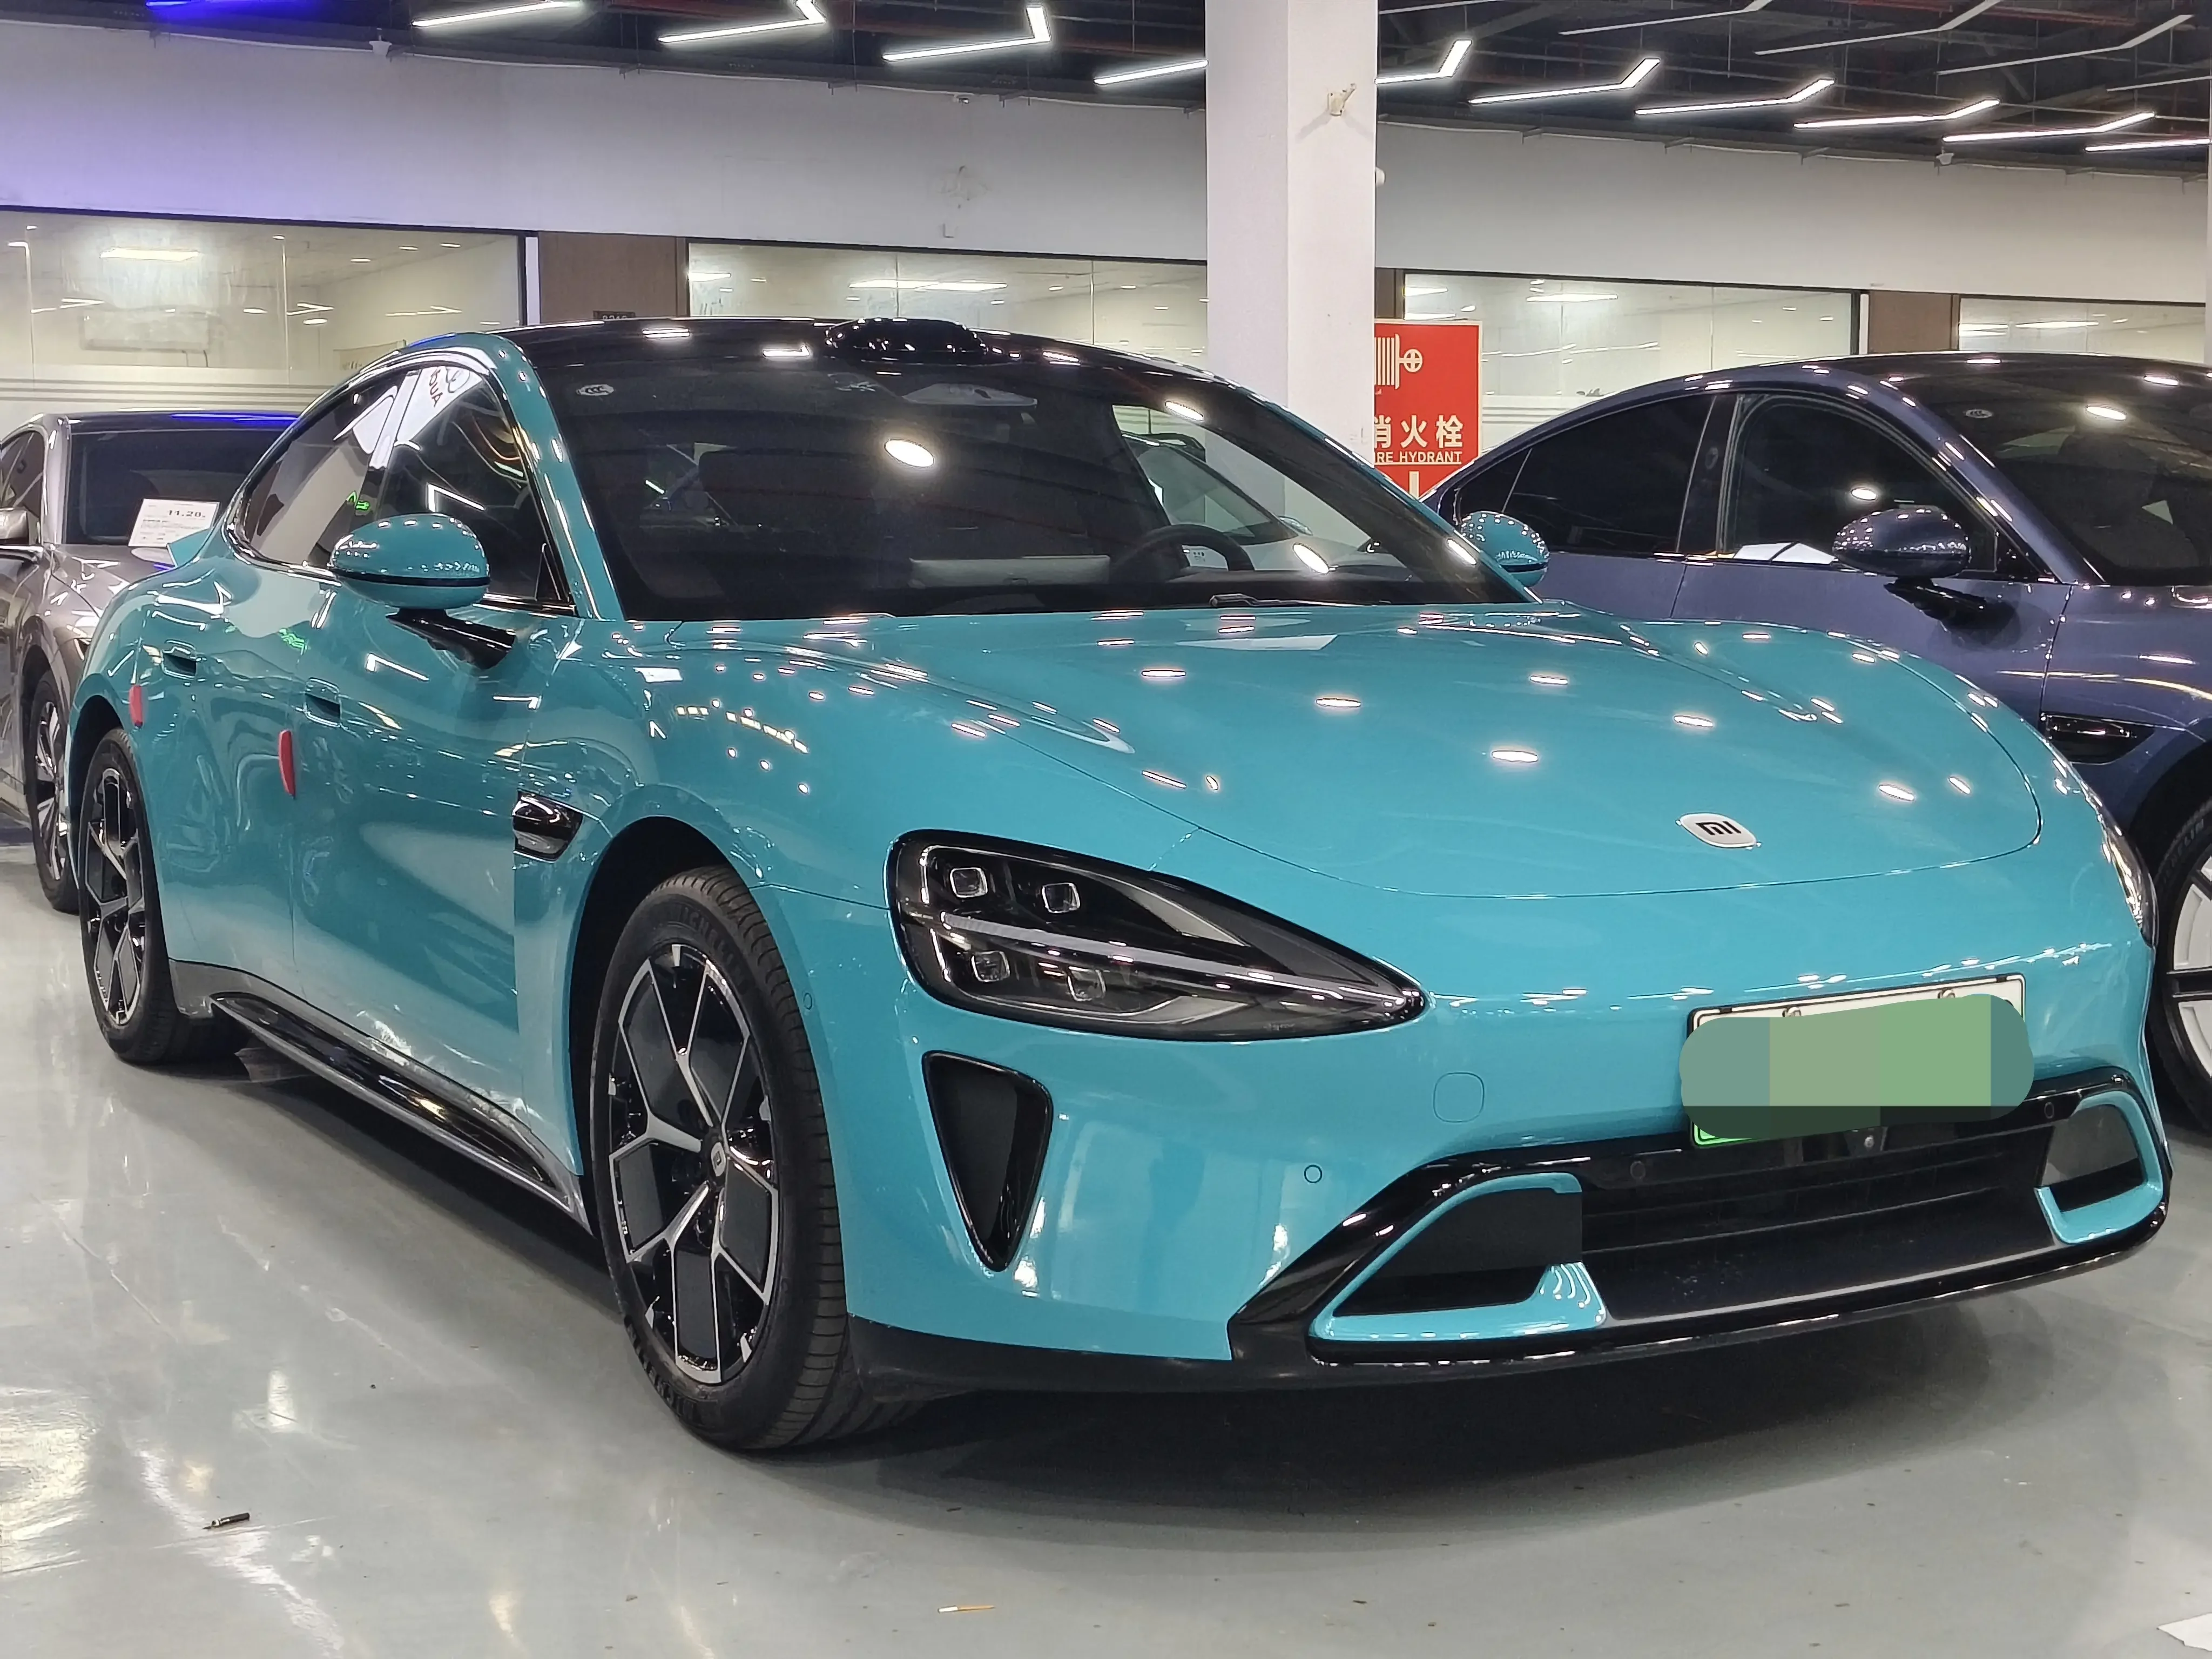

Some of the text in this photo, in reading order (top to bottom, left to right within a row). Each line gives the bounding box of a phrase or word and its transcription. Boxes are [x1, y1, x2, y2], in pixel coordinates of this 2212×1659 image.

[1374, 415, 1464, 448] 消火栓
[1374, 451, 1463, 463] RE HYDRANT
